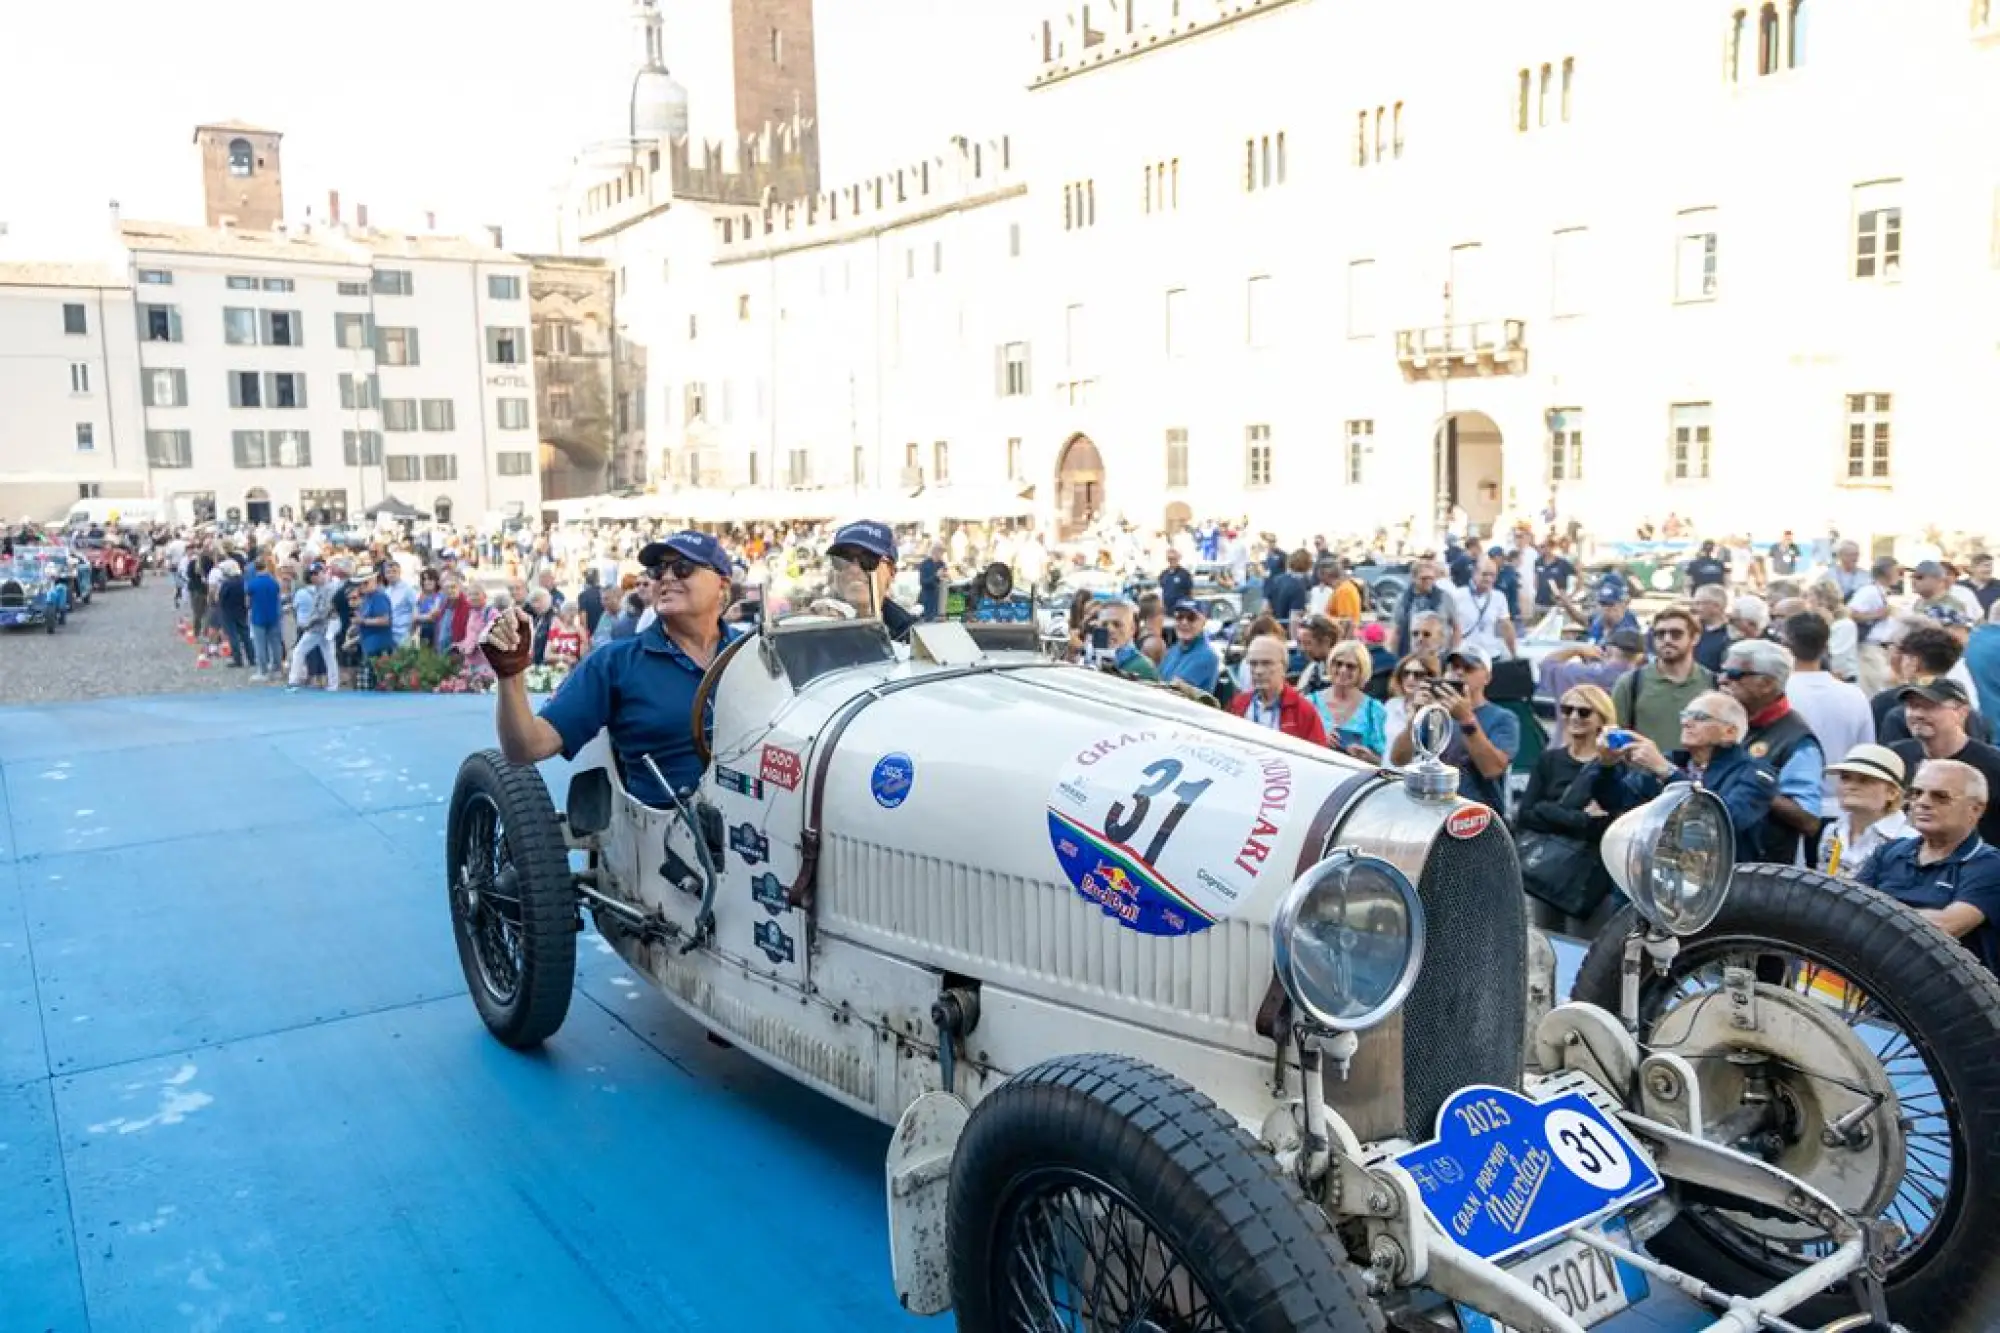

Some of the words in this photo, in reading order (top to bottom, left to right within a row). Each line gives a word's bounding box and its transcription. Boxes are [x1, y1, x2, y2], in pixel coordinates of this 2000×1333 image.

[487, 375, 528, 388] HOTEL
[1104, 758, 1214, 867] 31
[1455, 1098, 1511, 1136] 2025
[1560, 1122, 1617, 1173] 31
[1453, 1191, 1481, 1236] GRAN
[1475, 1141, 1508, 1195] PREMIO
